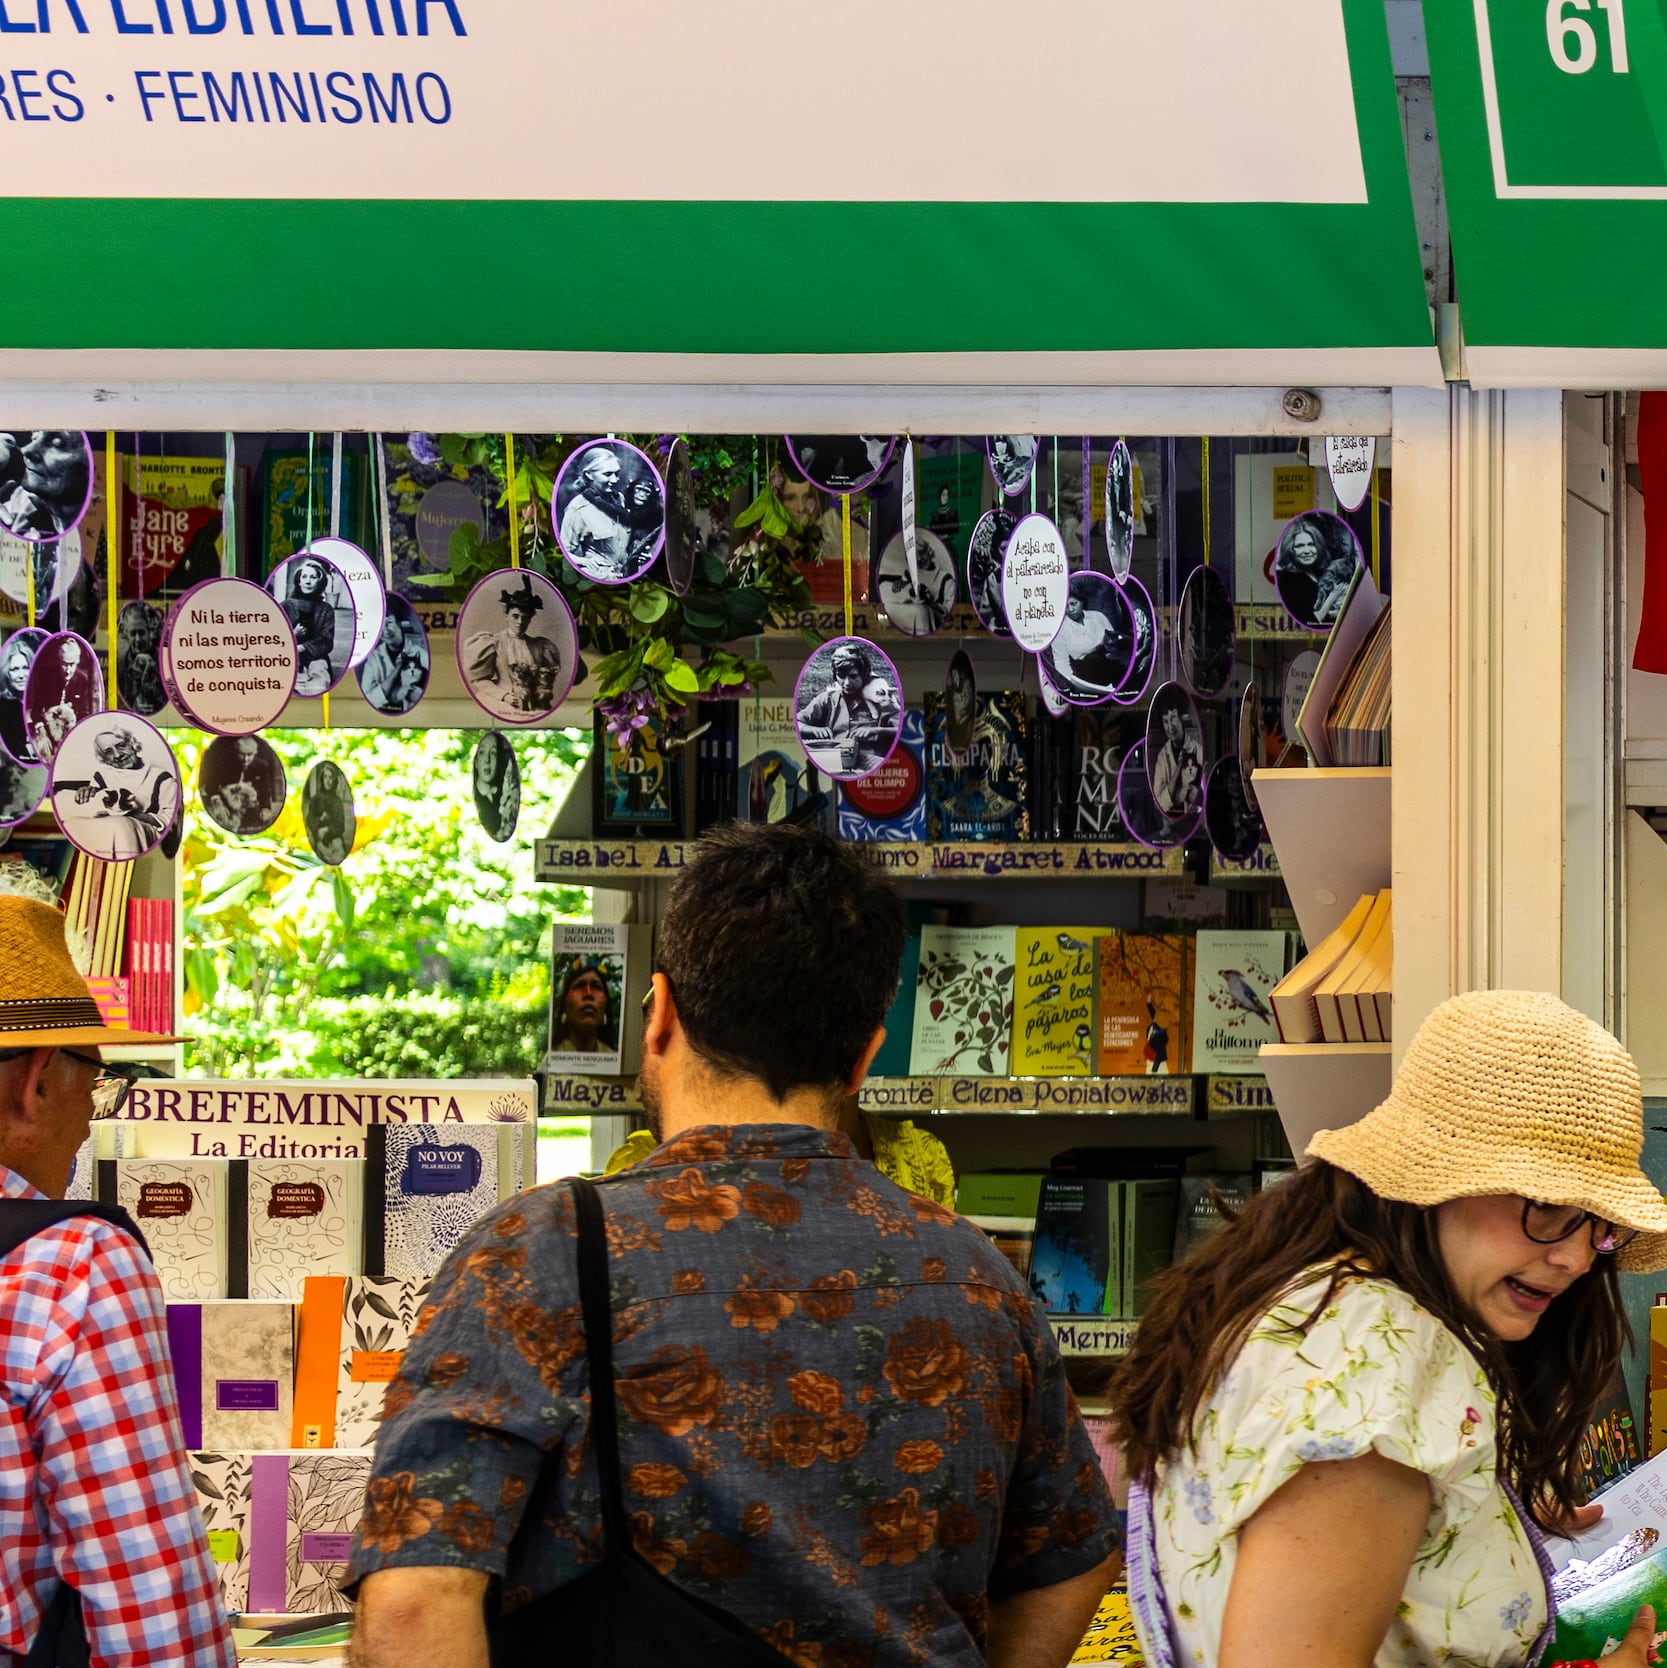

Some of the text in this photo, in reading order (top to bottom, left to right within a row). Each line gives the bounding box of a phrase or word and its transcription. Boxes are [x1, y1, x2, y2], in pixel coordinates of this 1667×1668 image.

[1546, 0, 1630, 74] 61
[134, 71, 452, 124] FEMINISMO
[130, 501, 189, 531] Jane
[1014, 538, 1055, 556] Acaba con
[1007, 561, 1013, 578] el
[1023, 586, 1046, 599] no con
[191, 608, 270, 625] Ni la tierra
[1016, 603, 1022, 620] el
[179, 633, 286, 651] ni las mujeres,
[177, 654, 291, 670] somos territorio
[187, 678, 285, 695] de conquista.
[857, 779, 905, 787] DEL OLIMPO
[544, 845, 642, 868] Isabel
[932, 848, 1165, 875] Margaret Atwood
[564, 927, 614, 935] SEREMOS
[564, 935, 615, 945] JAGUARES
[1028, 941, 1054, 967] La
[1028, 950, 1094, 988] casa de
[1069, 983, 1093, 1001] los
[1026, 1004, 1089, 1039] pájaros
[553, 1079, 626, 1108] Maya
[861, 1080, 1188, 1108] rontë Elena Poniatowska
[112, 1088, 465, 1127] BREFEMINISTA
[190, 1133, 368, 1159] La Editorial
[418, 1151, 465, 1162] NO VOY
[146, 1186, 184, 1195] GEOGRAFÍA
[276, 1186, 314, 1195] GEOGRAFÍA
